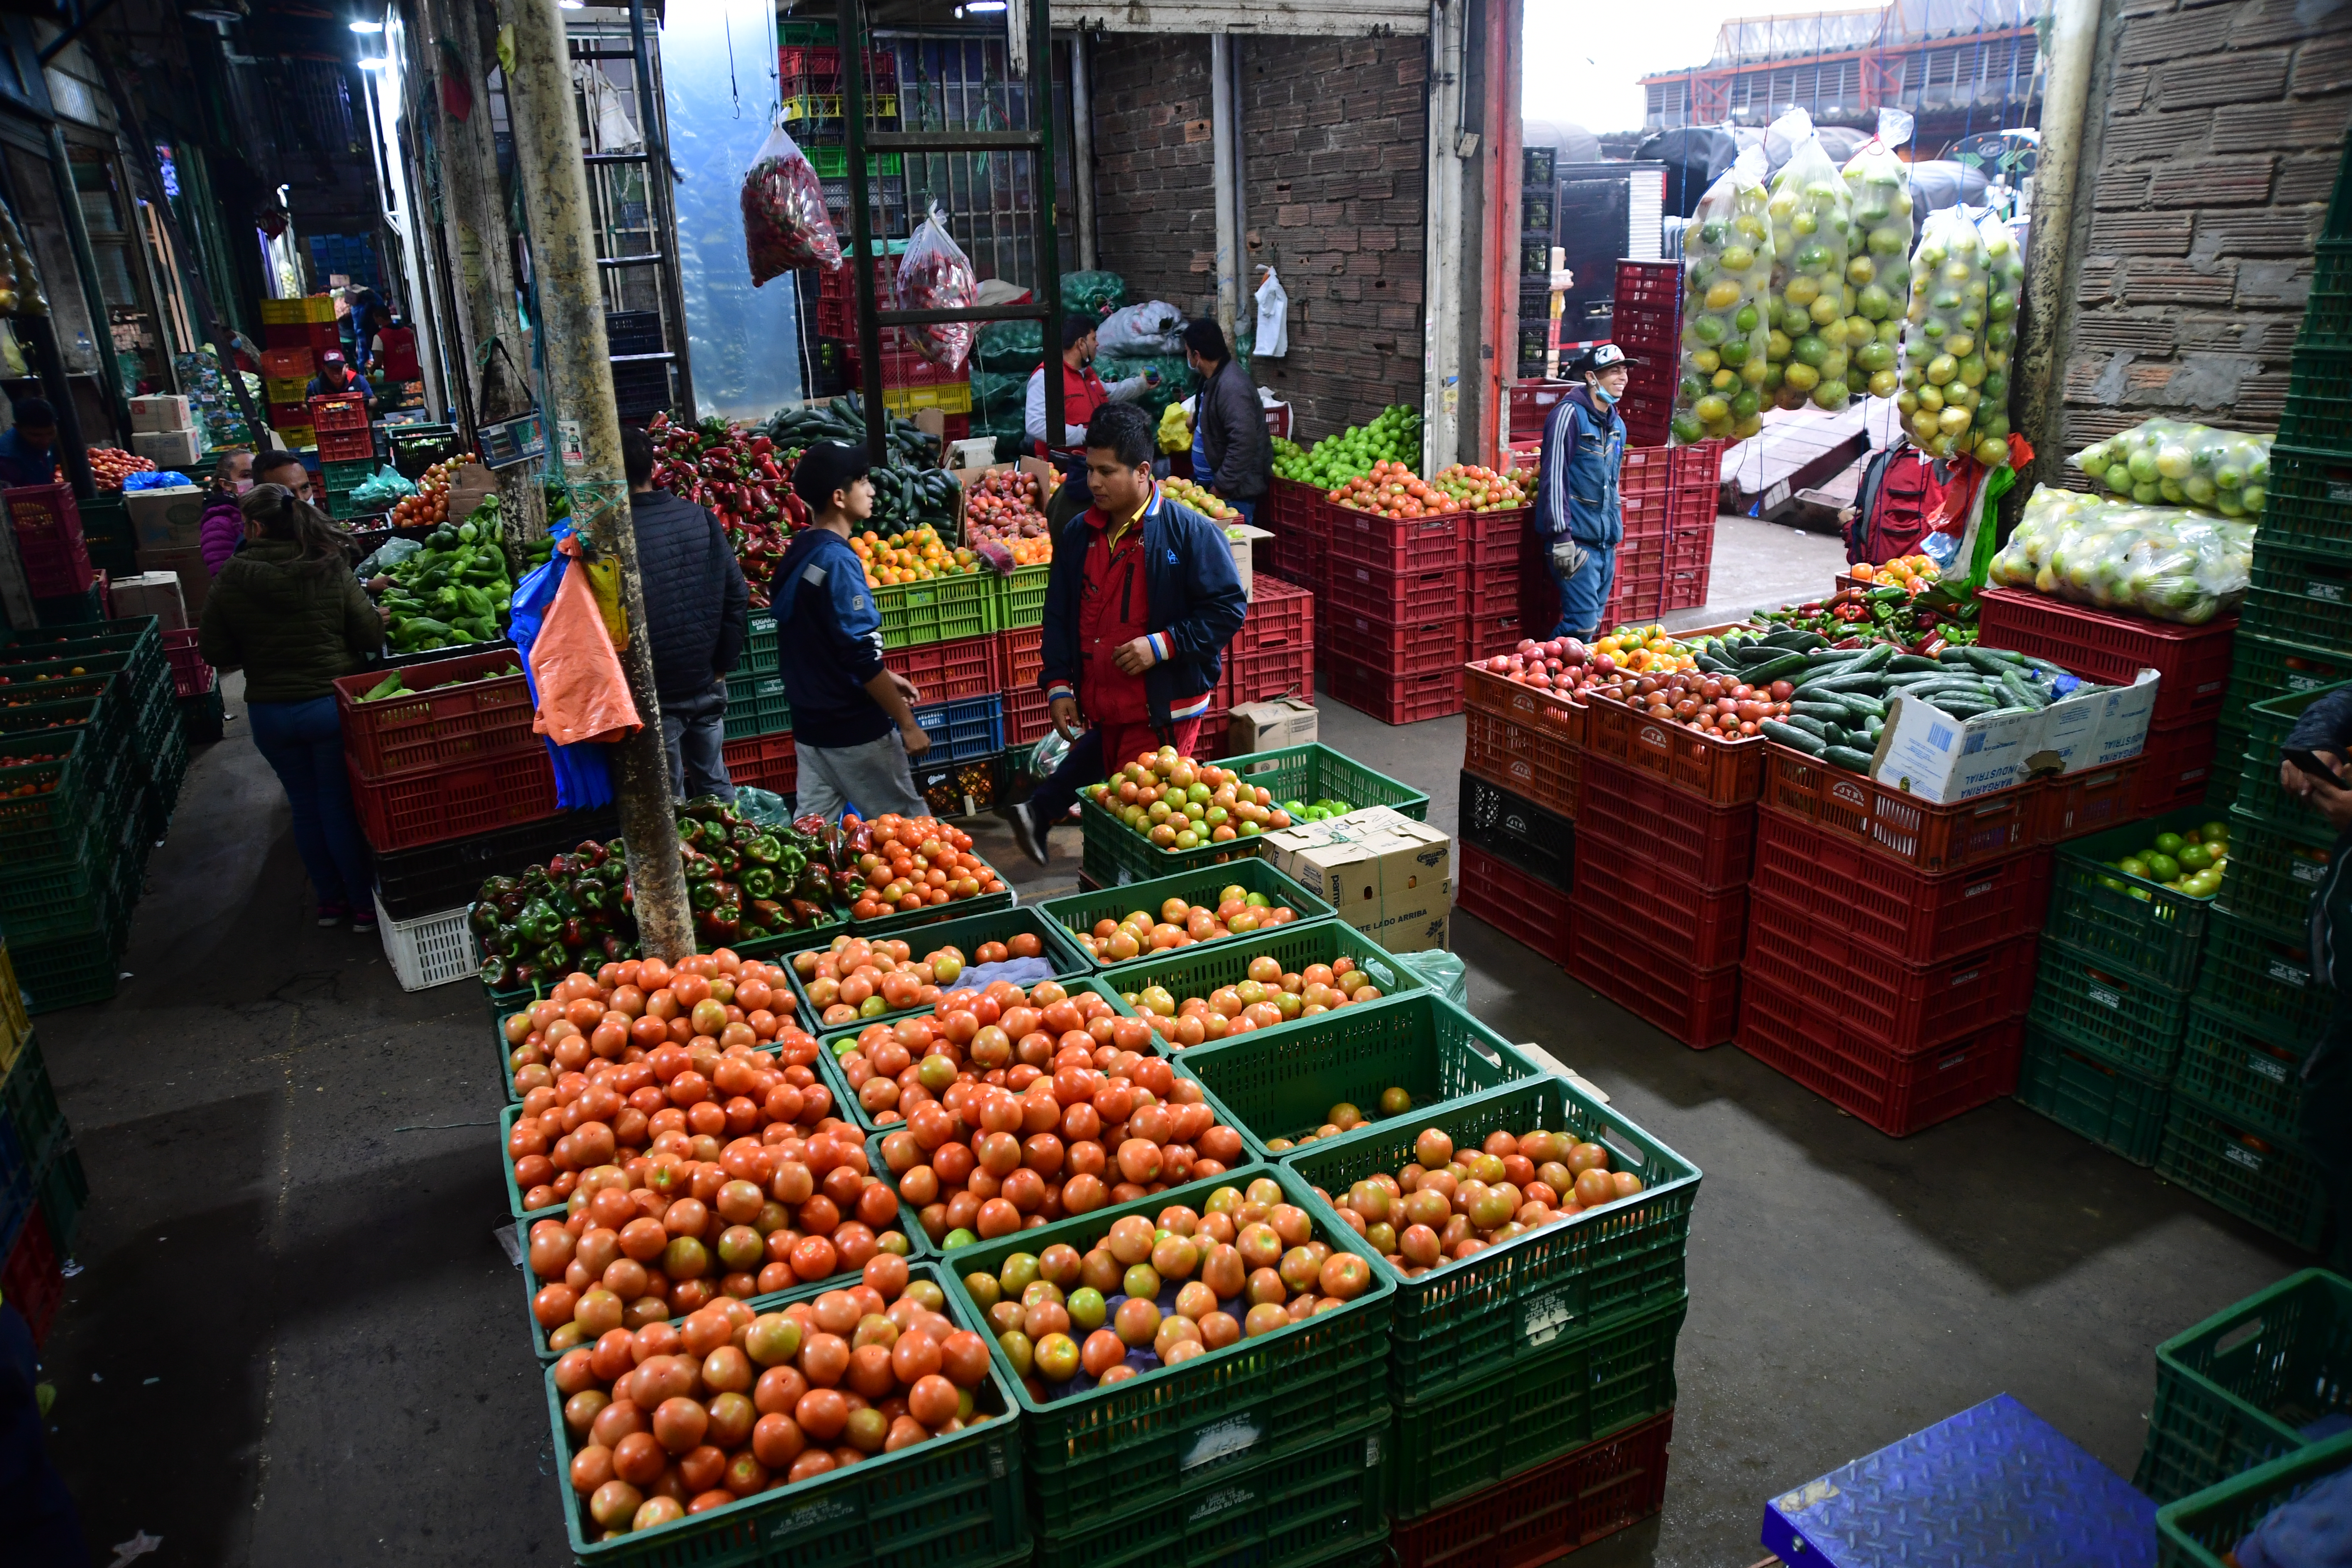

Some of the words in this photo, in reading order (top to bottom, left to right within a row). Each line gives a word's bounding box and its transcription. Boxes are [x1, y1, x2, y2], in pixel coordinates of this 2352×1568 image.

[752, 618, 771, 626] EDGAR
[918, 711, 943, 720] ARCANGEL
[921, 718, 940, 726] MIGUEL
[1966, 765, 2018, 784] INDUSTRIAL
[1961, 777, 2014, 798] MARGARINA
[1419, 848, 1446, 862] parmalat
[1331, 874, 1340, 908] parma
[1443, 883, 1448, 894] 2
[1356, 923, 1371, 933] STE
[1373, 918, 1395, 929] LADO
[1397, 909, 1427, 923] ARRIBA
[1523, 1285, 1570, 1306] TOMATES
[1194, 1412, 1250, 1436] TOMATES
[1234, 1492, 1255, 1505] VENTA
